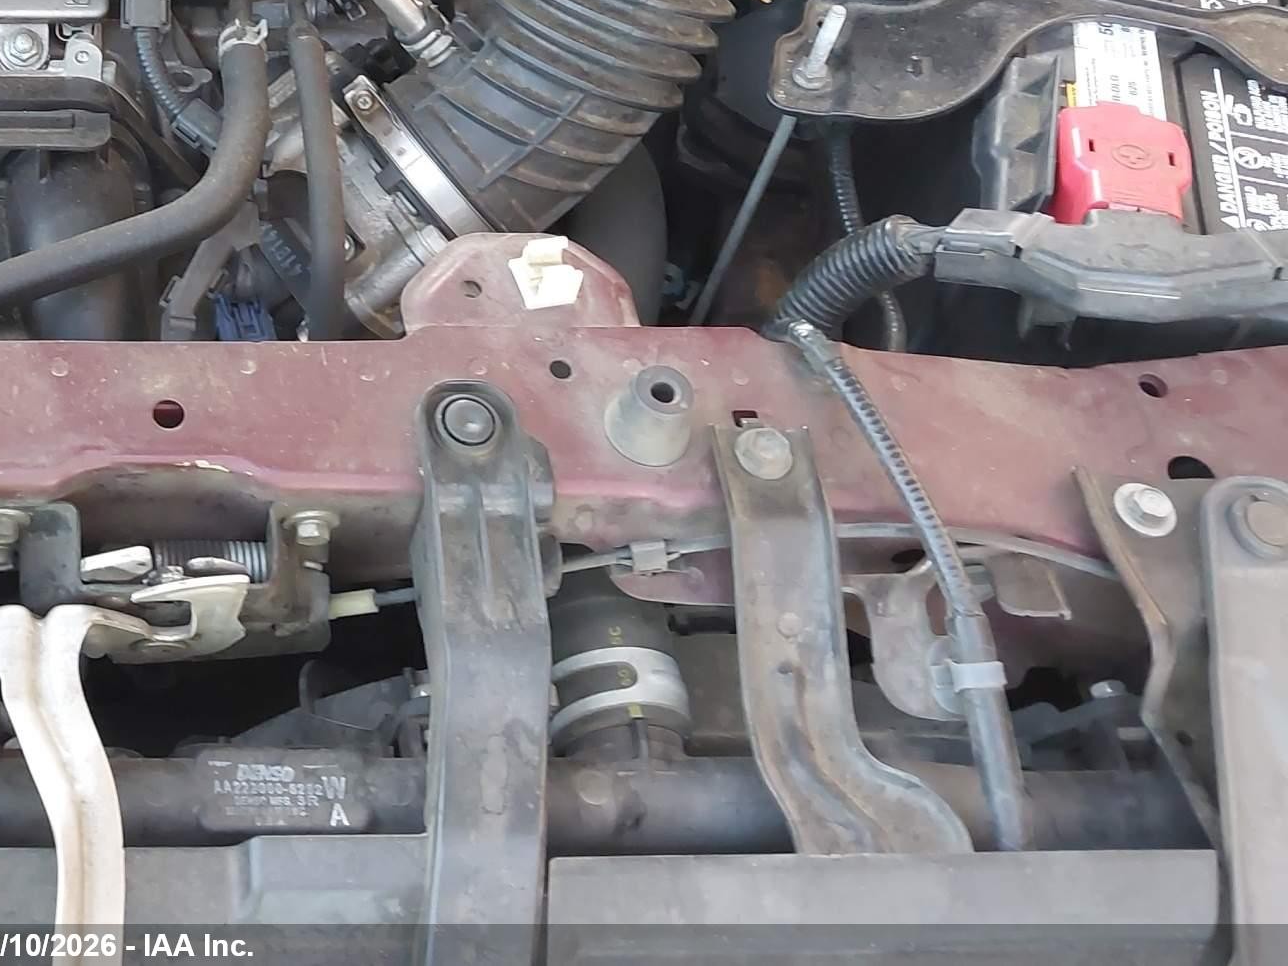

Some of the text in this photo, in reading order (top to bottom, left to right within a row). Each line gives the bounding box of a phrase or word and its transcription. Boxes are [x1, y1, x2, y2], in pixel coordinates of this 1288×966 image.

[236, 763, 296, 782] DENSO
[321, 776, 346, 799] W
[330, 802, 350, 827] A
